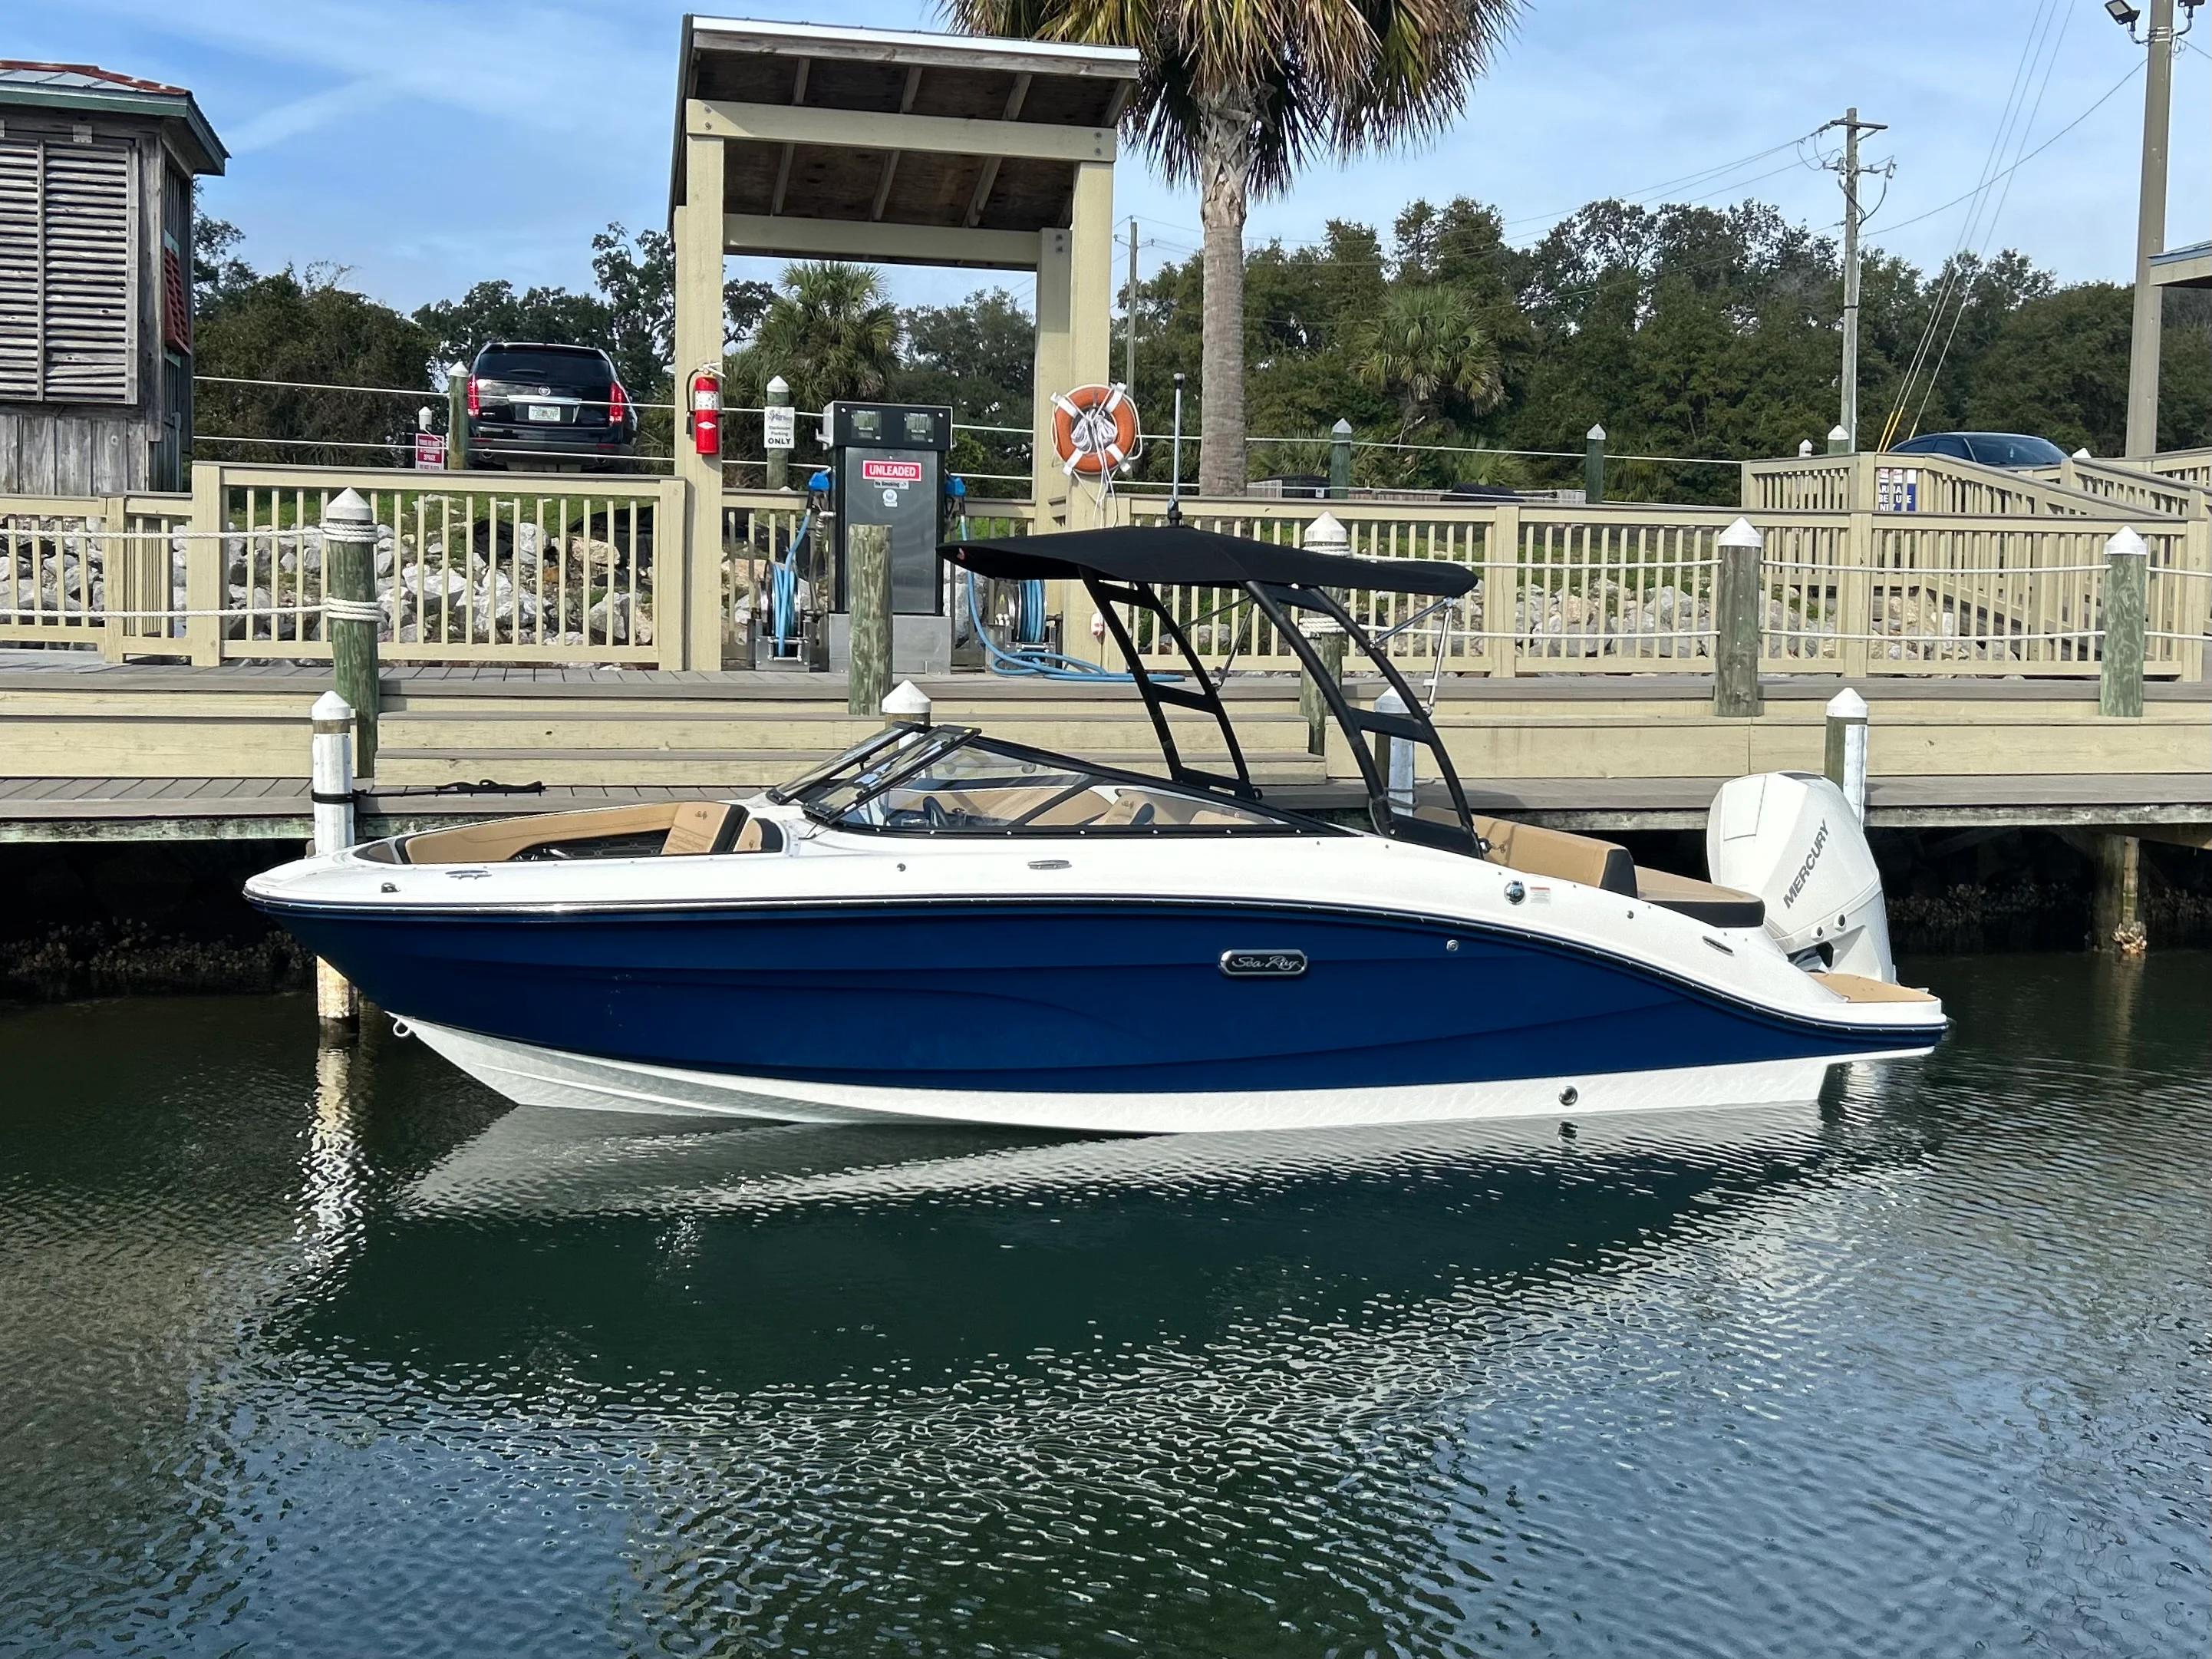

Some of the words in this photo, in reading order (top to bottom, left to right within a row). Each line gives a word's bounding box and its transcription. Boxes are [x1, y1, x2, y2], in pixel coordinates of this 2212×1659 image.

[869, 465, 916, 477] UNLEADED
[1895, 495, 1912, 503] UE
[1783, 818, 1828, 909] MERCURY
[1231, 957, 1264, 968] Sea
[1265, 955, 1301, 970] Ray
